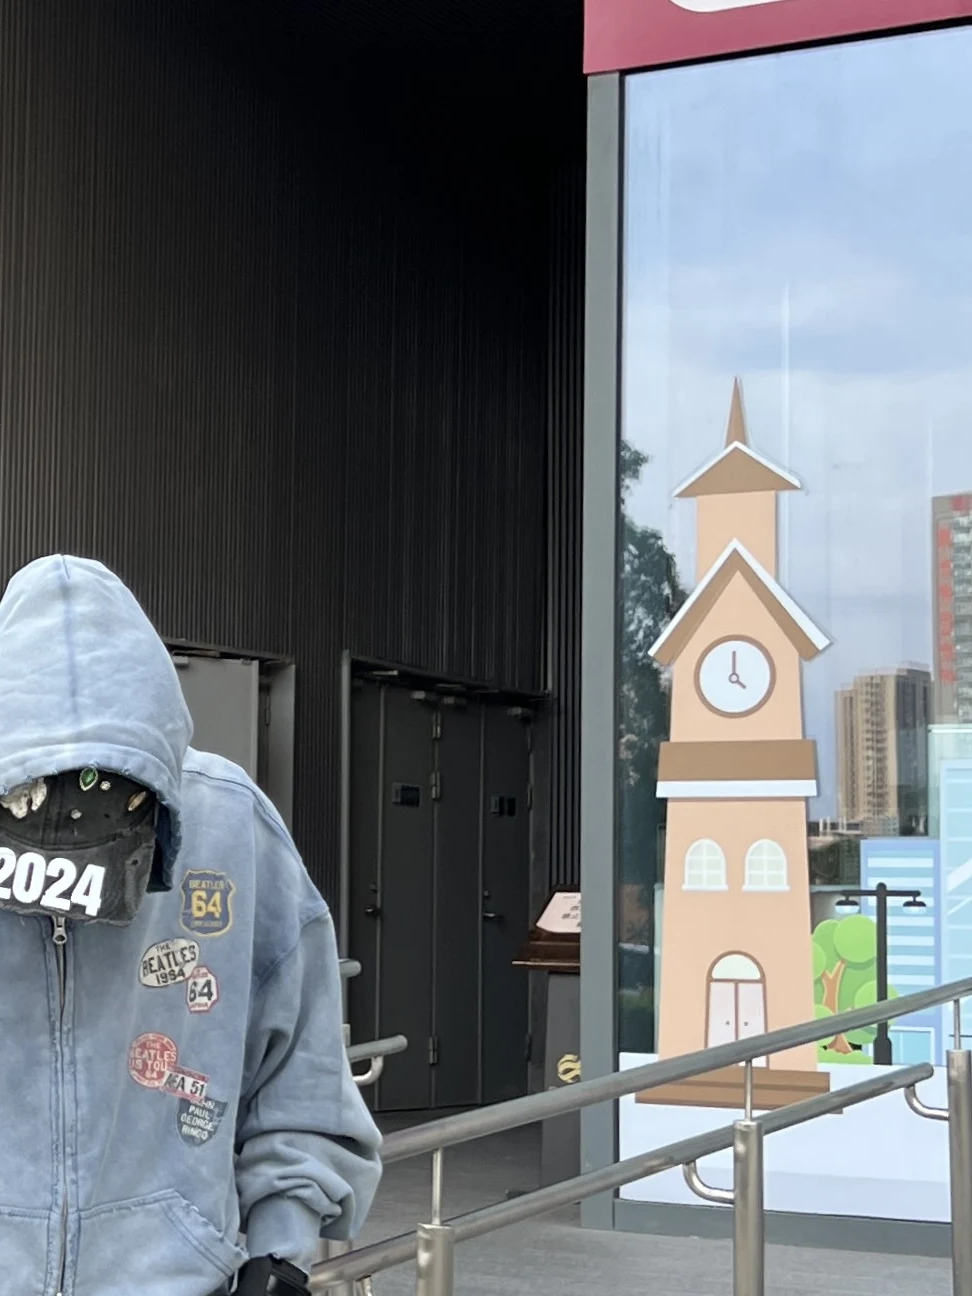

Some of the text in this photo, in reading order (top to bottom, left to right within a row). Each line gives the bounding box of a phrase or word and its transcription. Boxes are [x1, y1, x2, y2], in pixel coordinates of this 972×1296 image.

[189, 880, 225, 889] BEATLES
[191, 890, 222, 918] 64
[155, 943, 171, 953] THE
[142, 945, 197, 978] BEATLES
[189, 979, 214, 1003] 64
[146, 1041, 161, 1049] THE
[129, 1047, 177, 1062] BEATLES
[129, 1058, 143, 1070] US
[190, 1080, 206, 1097] 51
[189, 1105, 210, 1120] PAUL
[181, 1113, 214, 1131] GEORGE
